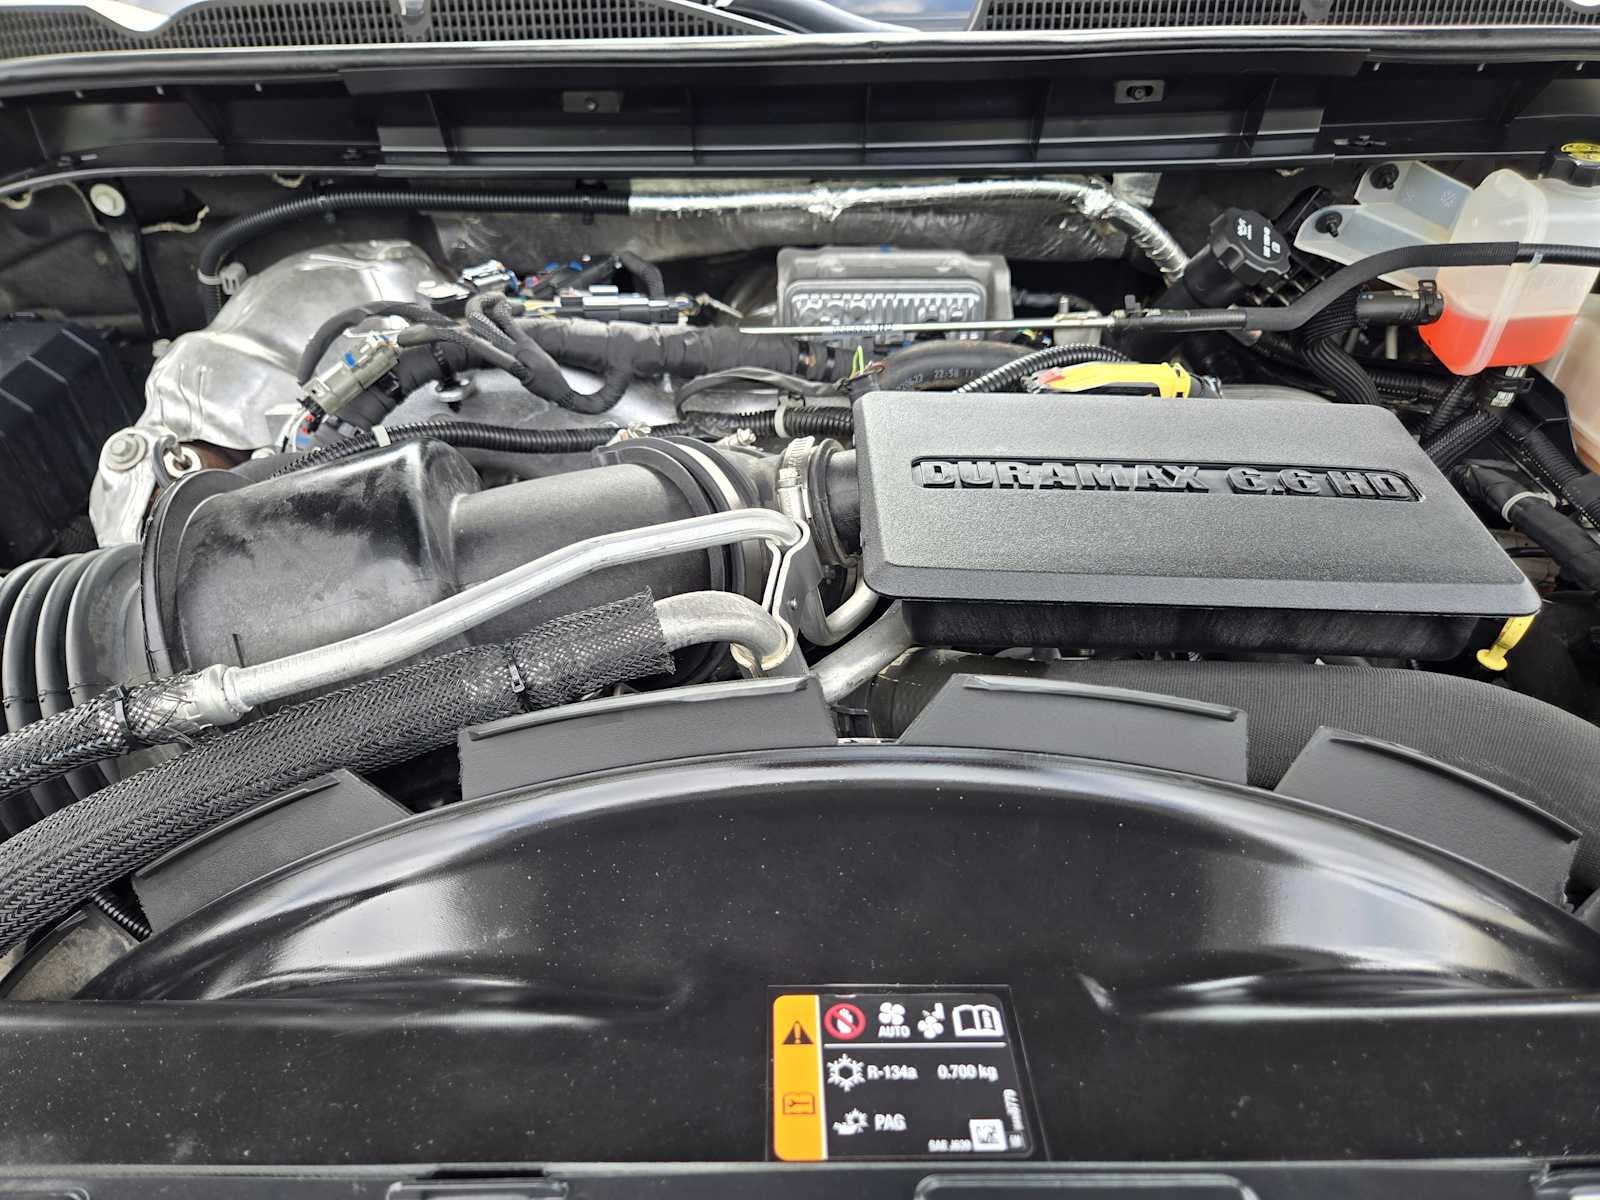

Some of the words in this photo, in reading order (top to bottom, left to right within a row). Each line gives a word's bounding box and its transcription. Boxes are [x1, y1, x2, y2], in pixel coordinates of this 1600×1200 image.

[919, 460, 1210, 494] DURAMAX
[1226, 466, 1322, 496] 6.6
[1326, 469, 1412, 499] HD
[878, 1025, 911, 1038] AUTO
[866, 1064, 918, 1081] R-134a
[937, 1063, 978, 1080] 0.700
[978, 1063, 999, 1082] kg
[873, 1113, 908, 1131] PAG
